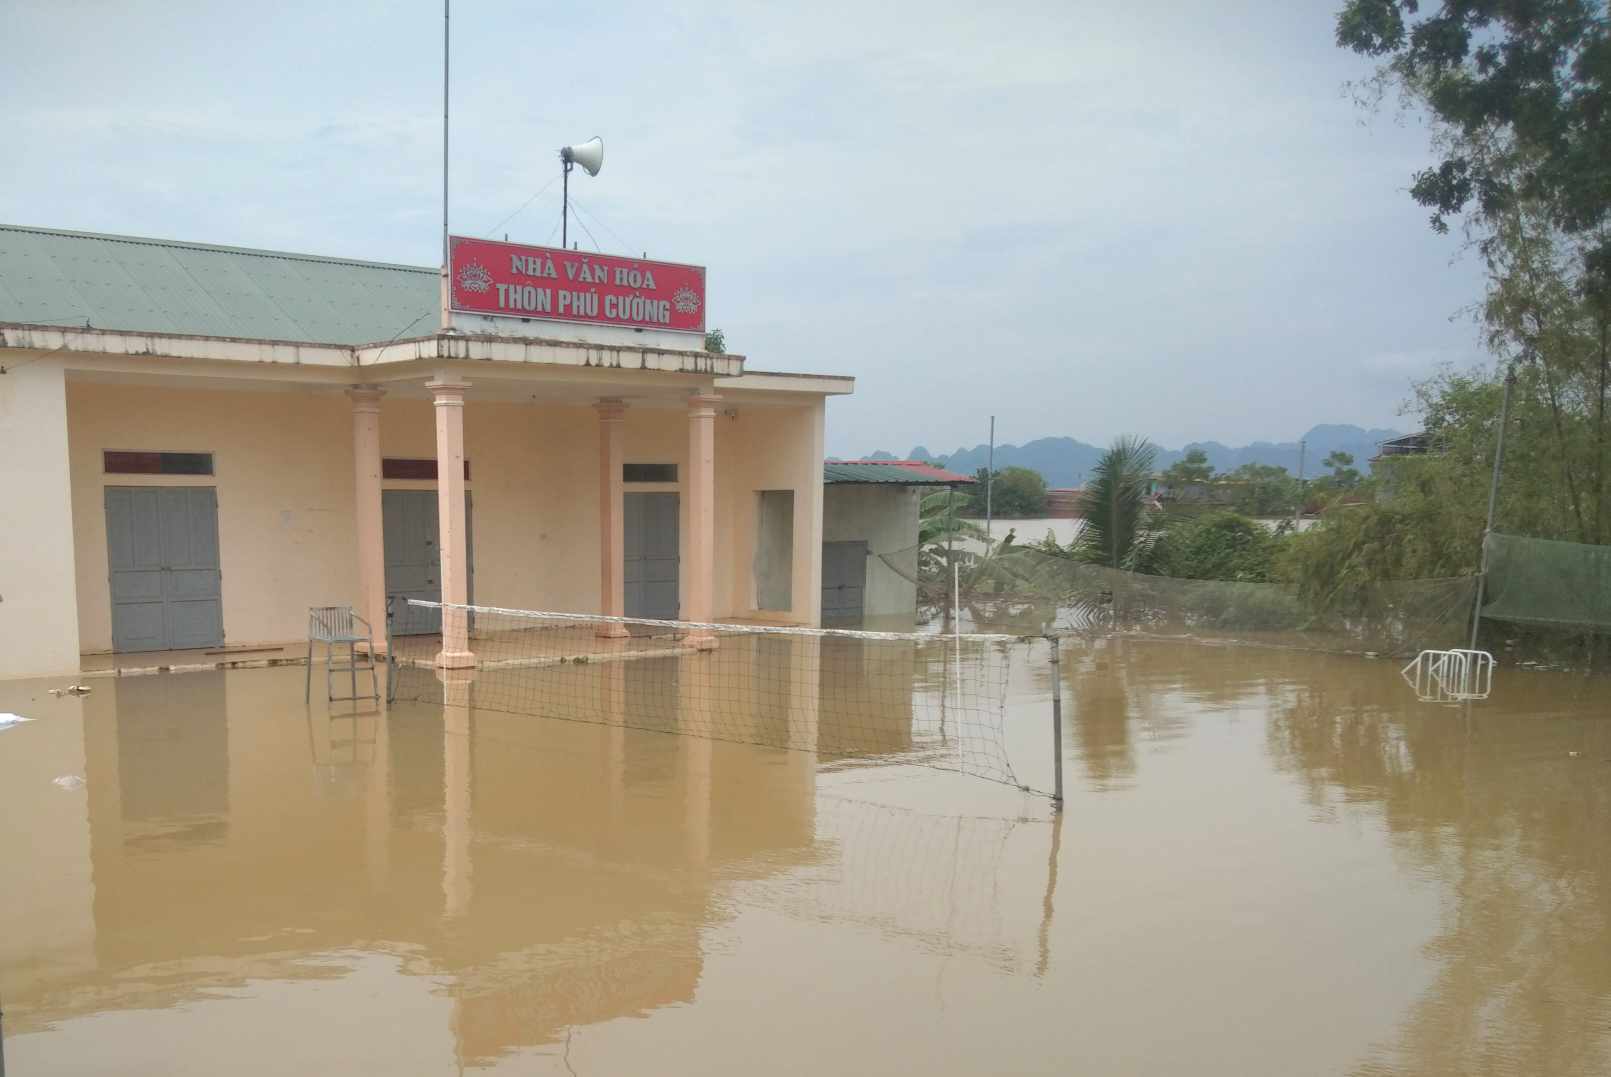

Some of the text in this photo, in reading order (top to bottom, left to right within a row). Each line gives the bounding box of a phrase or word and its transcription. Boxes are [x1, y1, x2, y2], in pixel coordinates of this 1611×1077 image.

[511, 253, 558, 279] NHÀ
[564, 257, 608, 284] VĂN
[496, 281, 671, 323] THÔN PHÚ CƯỜNG
